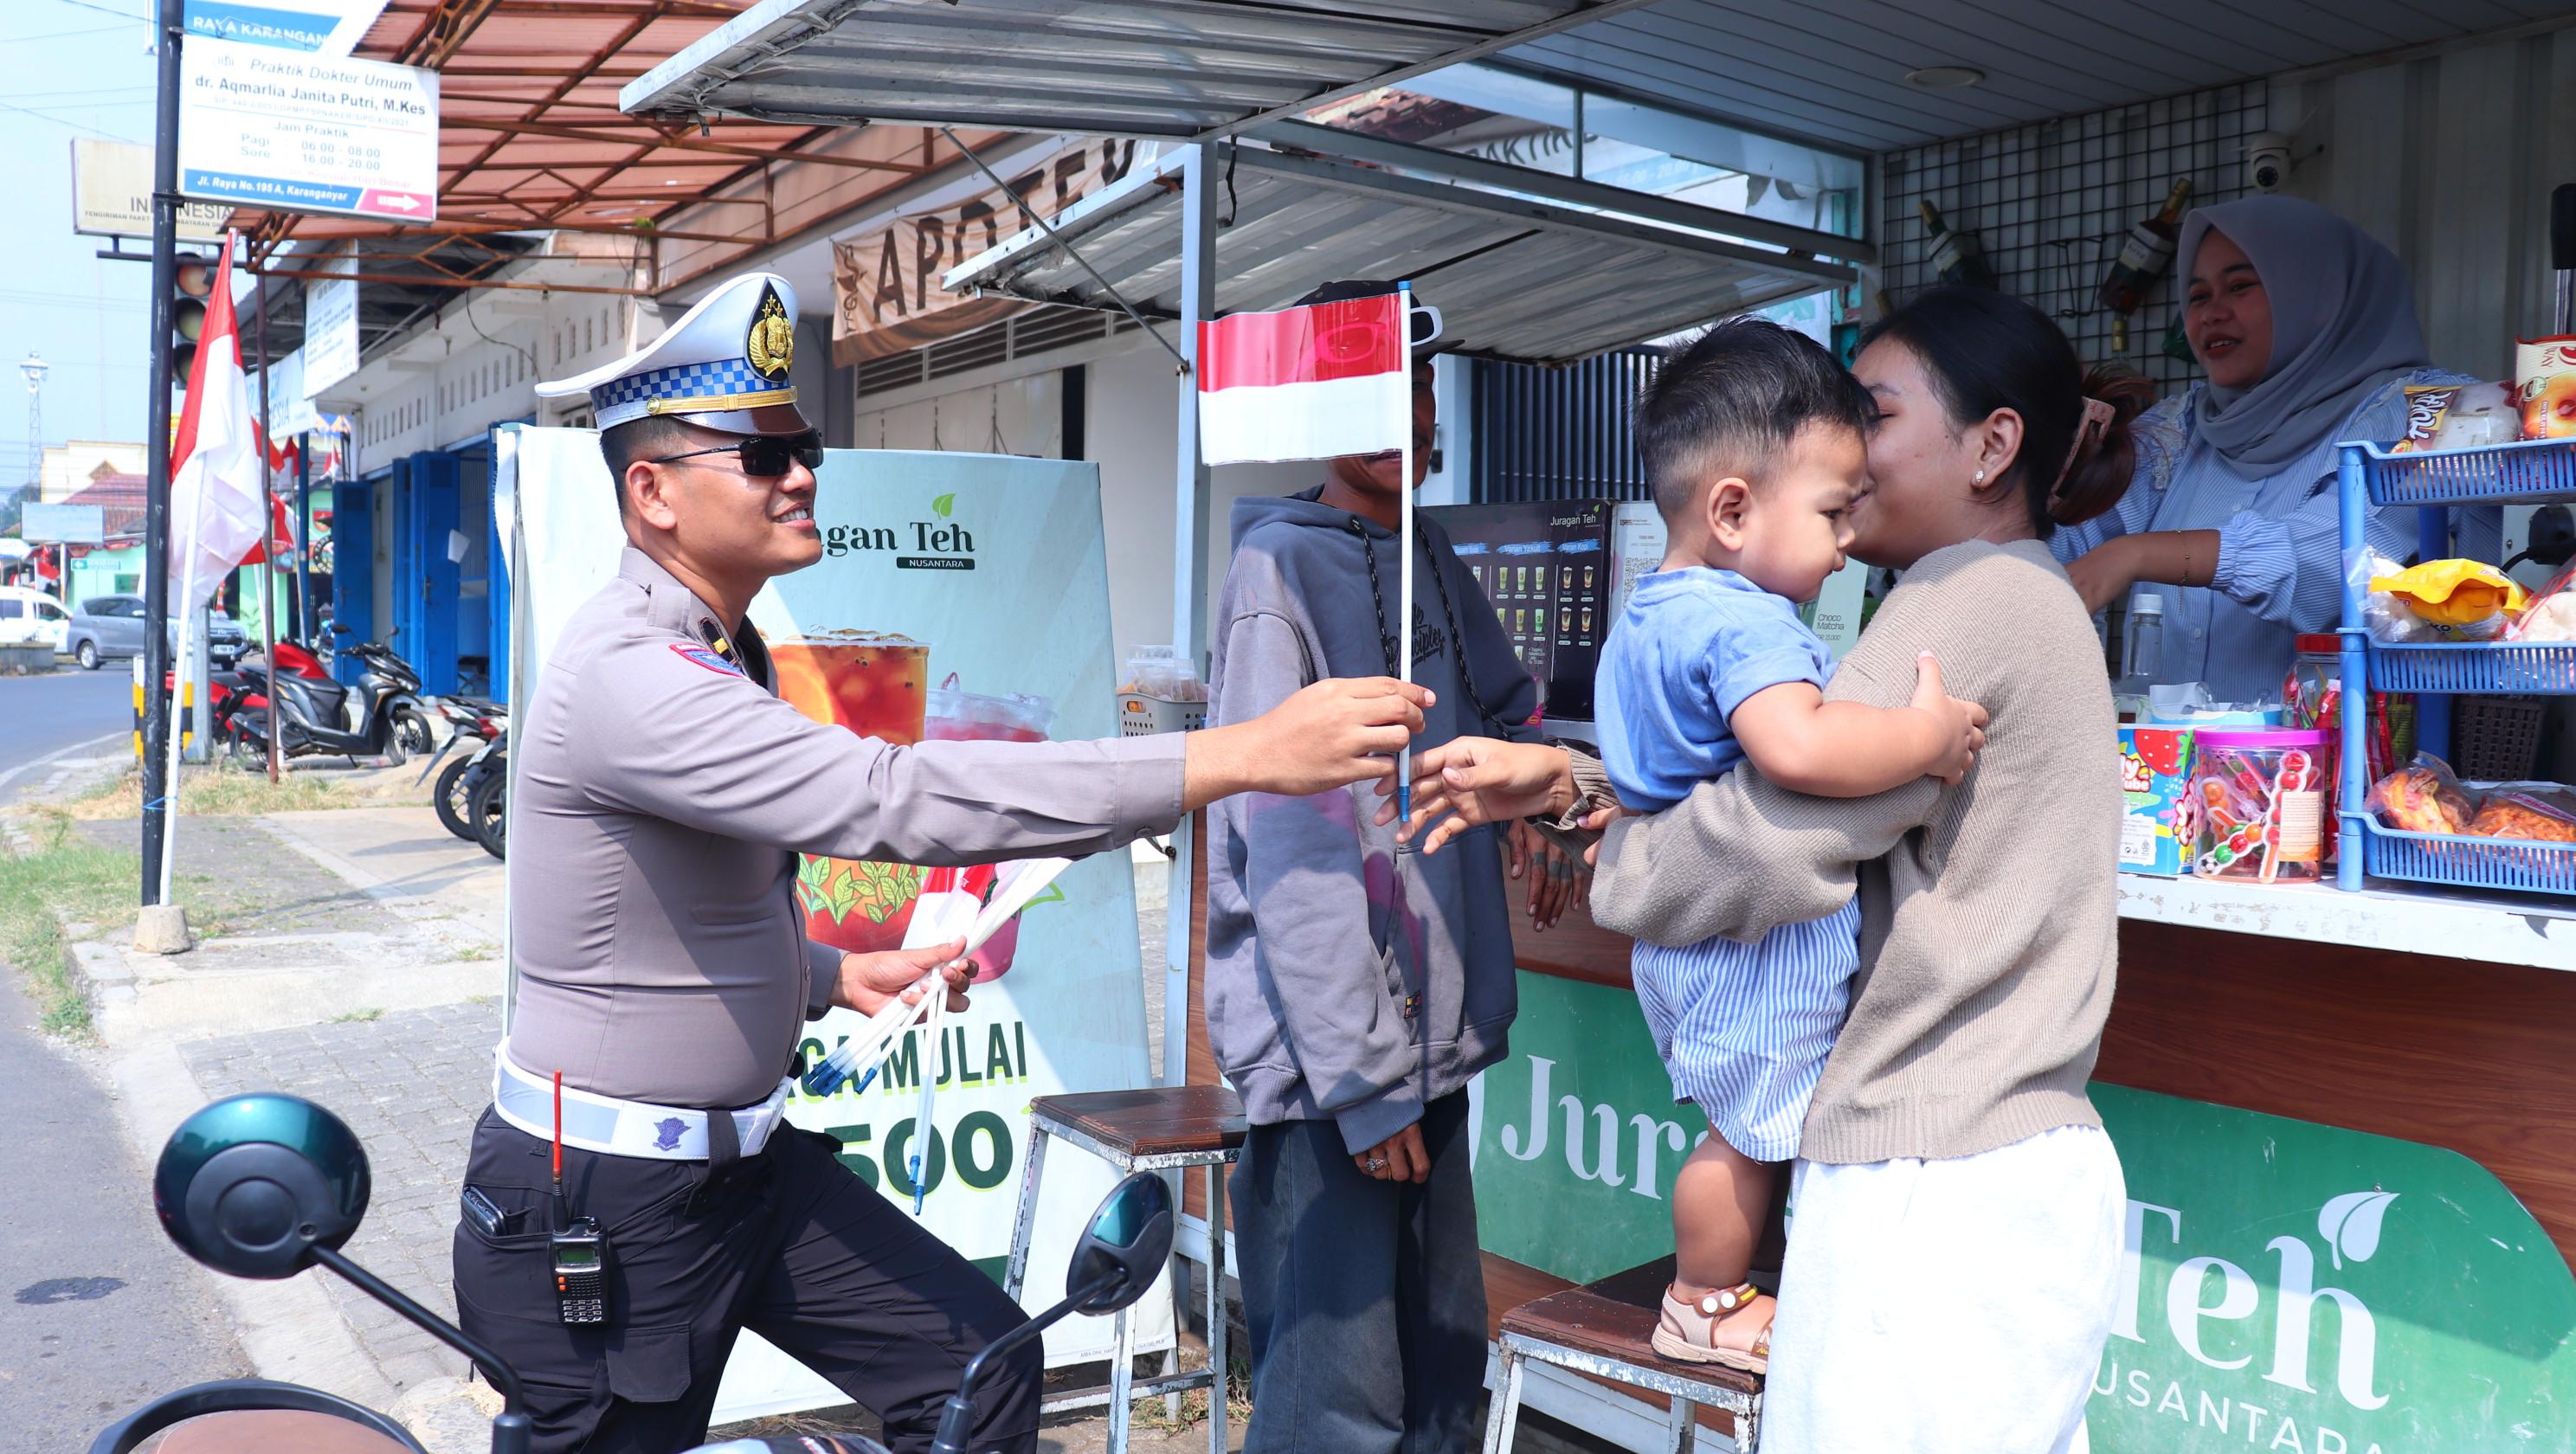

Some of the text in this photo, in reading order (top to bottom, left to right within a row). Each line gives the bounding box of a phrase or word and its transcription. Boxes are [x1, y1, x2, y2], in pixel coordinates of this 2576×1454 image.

[193, 16, 237, 34] RAYA
[250, 58, 303, 77] Praktik
[309, 67, 360, 84] Dokter
[364, 74, 412, 91] Umum
[195, 74, 426, 115] dr. Aqmarlia Janita Putri, M.Kes
[274, 121, 350, 138] Jam Praktik
[241, 145, 271, 159] Sore
[303, 153, 335, 165] 16.00
[348, 158, 381, 171] 20.00
[242, 133, 270, 147] Pagi
[301, 140, 335, 153] 06.00
[347, 145, 381, 158] 08.00
[196, 176, 210, 186] Jl.
[212, 177, 237, 190] Raya
[287, 185, 349, 203] Karanganyar
[130, 196, 232, 220] INNESIA
[1550, 513, 1596, 528] Juragan Teh
[910, 521, 976, 553] Teh
[909, 559, 964, 569] NUSANTARA
[2109, 1199, 2391, 1412] Teh
